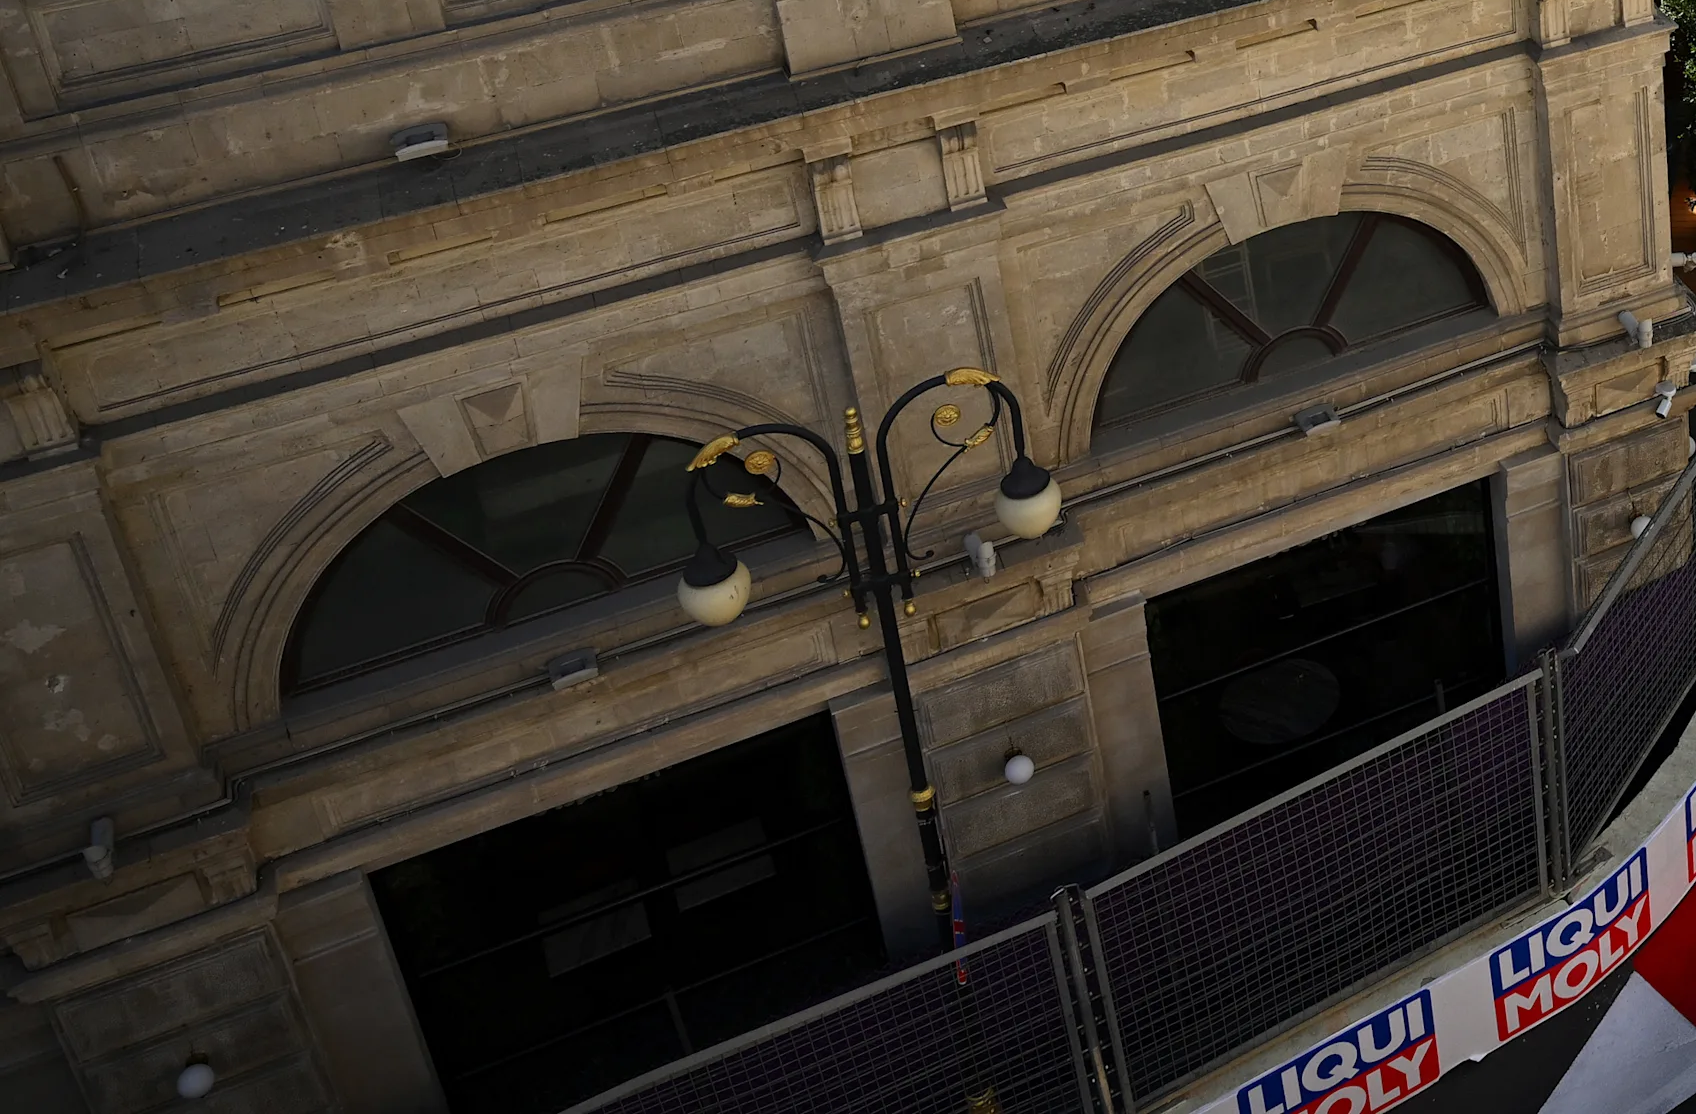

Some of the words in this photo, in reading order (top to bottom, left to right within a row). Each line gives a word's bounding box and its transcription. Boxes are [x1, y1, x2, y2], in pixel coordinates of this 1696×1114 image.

[1502, 855, 1643, 990] LIQUI
[1507, 898, 1650, 1034] MOLY
[1247, 997, 1426, 1114] LIQUI
[1298, 1038, 1434, 1114] OLY
